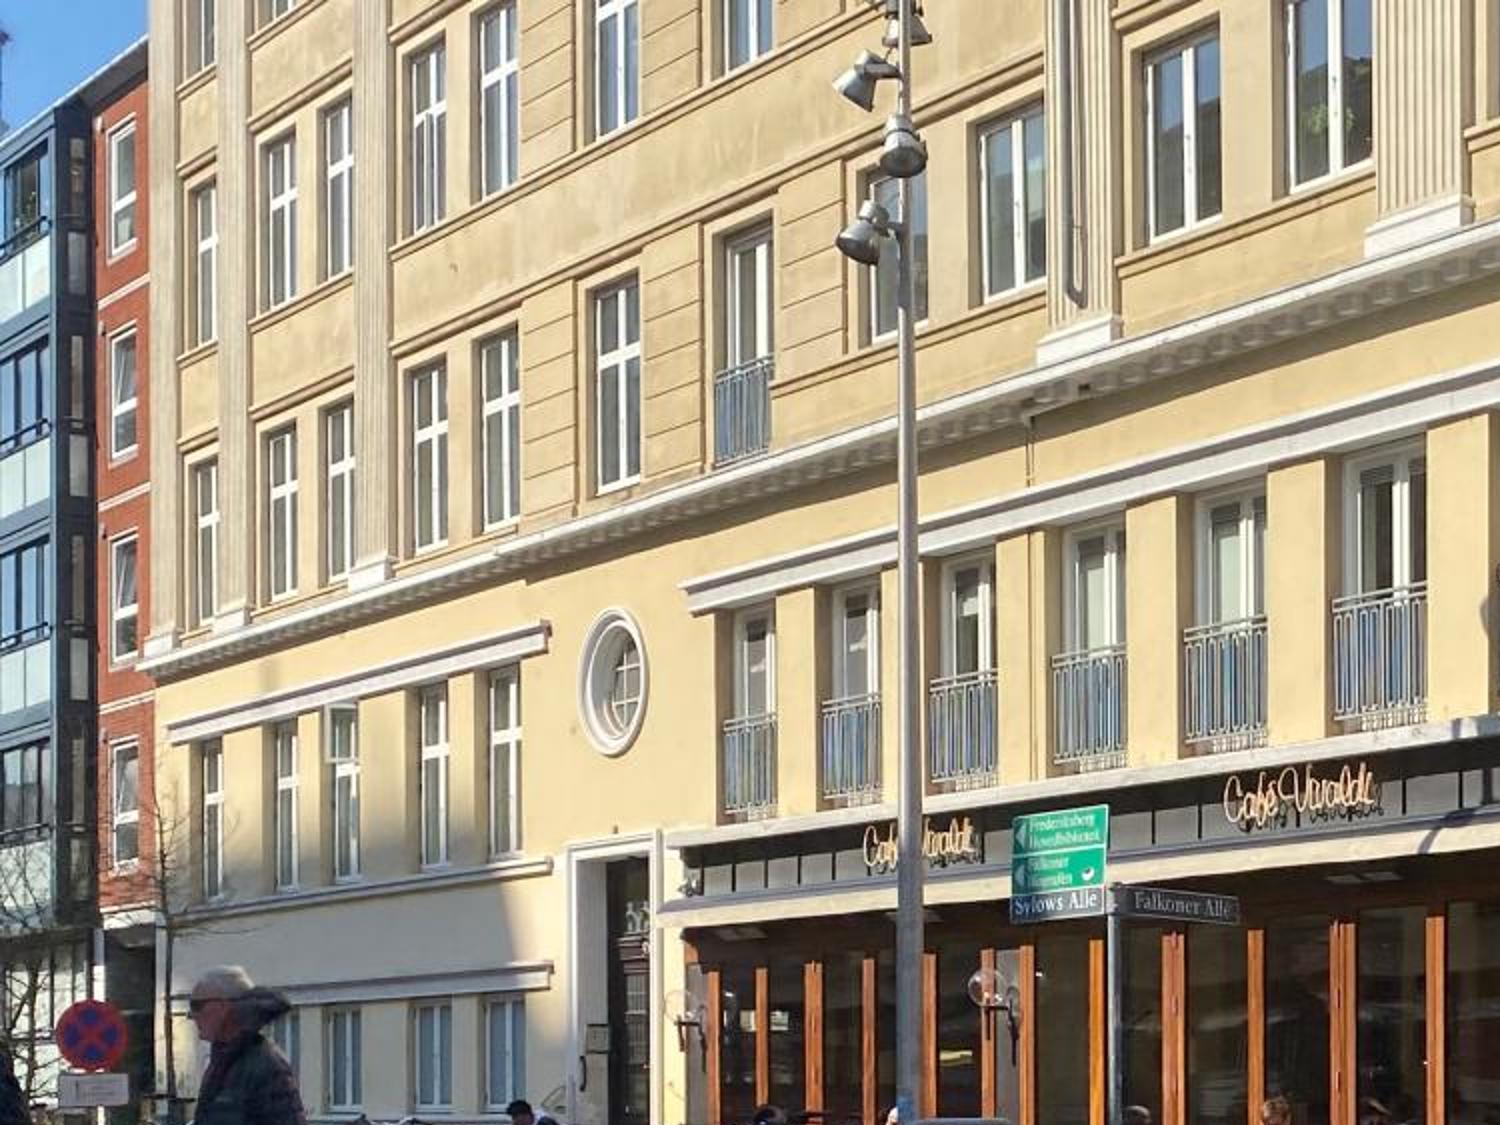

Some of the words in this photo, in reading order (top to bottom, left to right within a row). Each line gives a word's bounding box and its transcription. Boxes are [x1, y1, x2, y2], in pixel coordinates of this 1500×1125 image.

[1224, 771, 1279, 826] Café
[1278, 762, 1375, 812] Vivaldi
[863, 822, 898, 870] Caf
[1134, 891, 1200, 915] Falkoner
